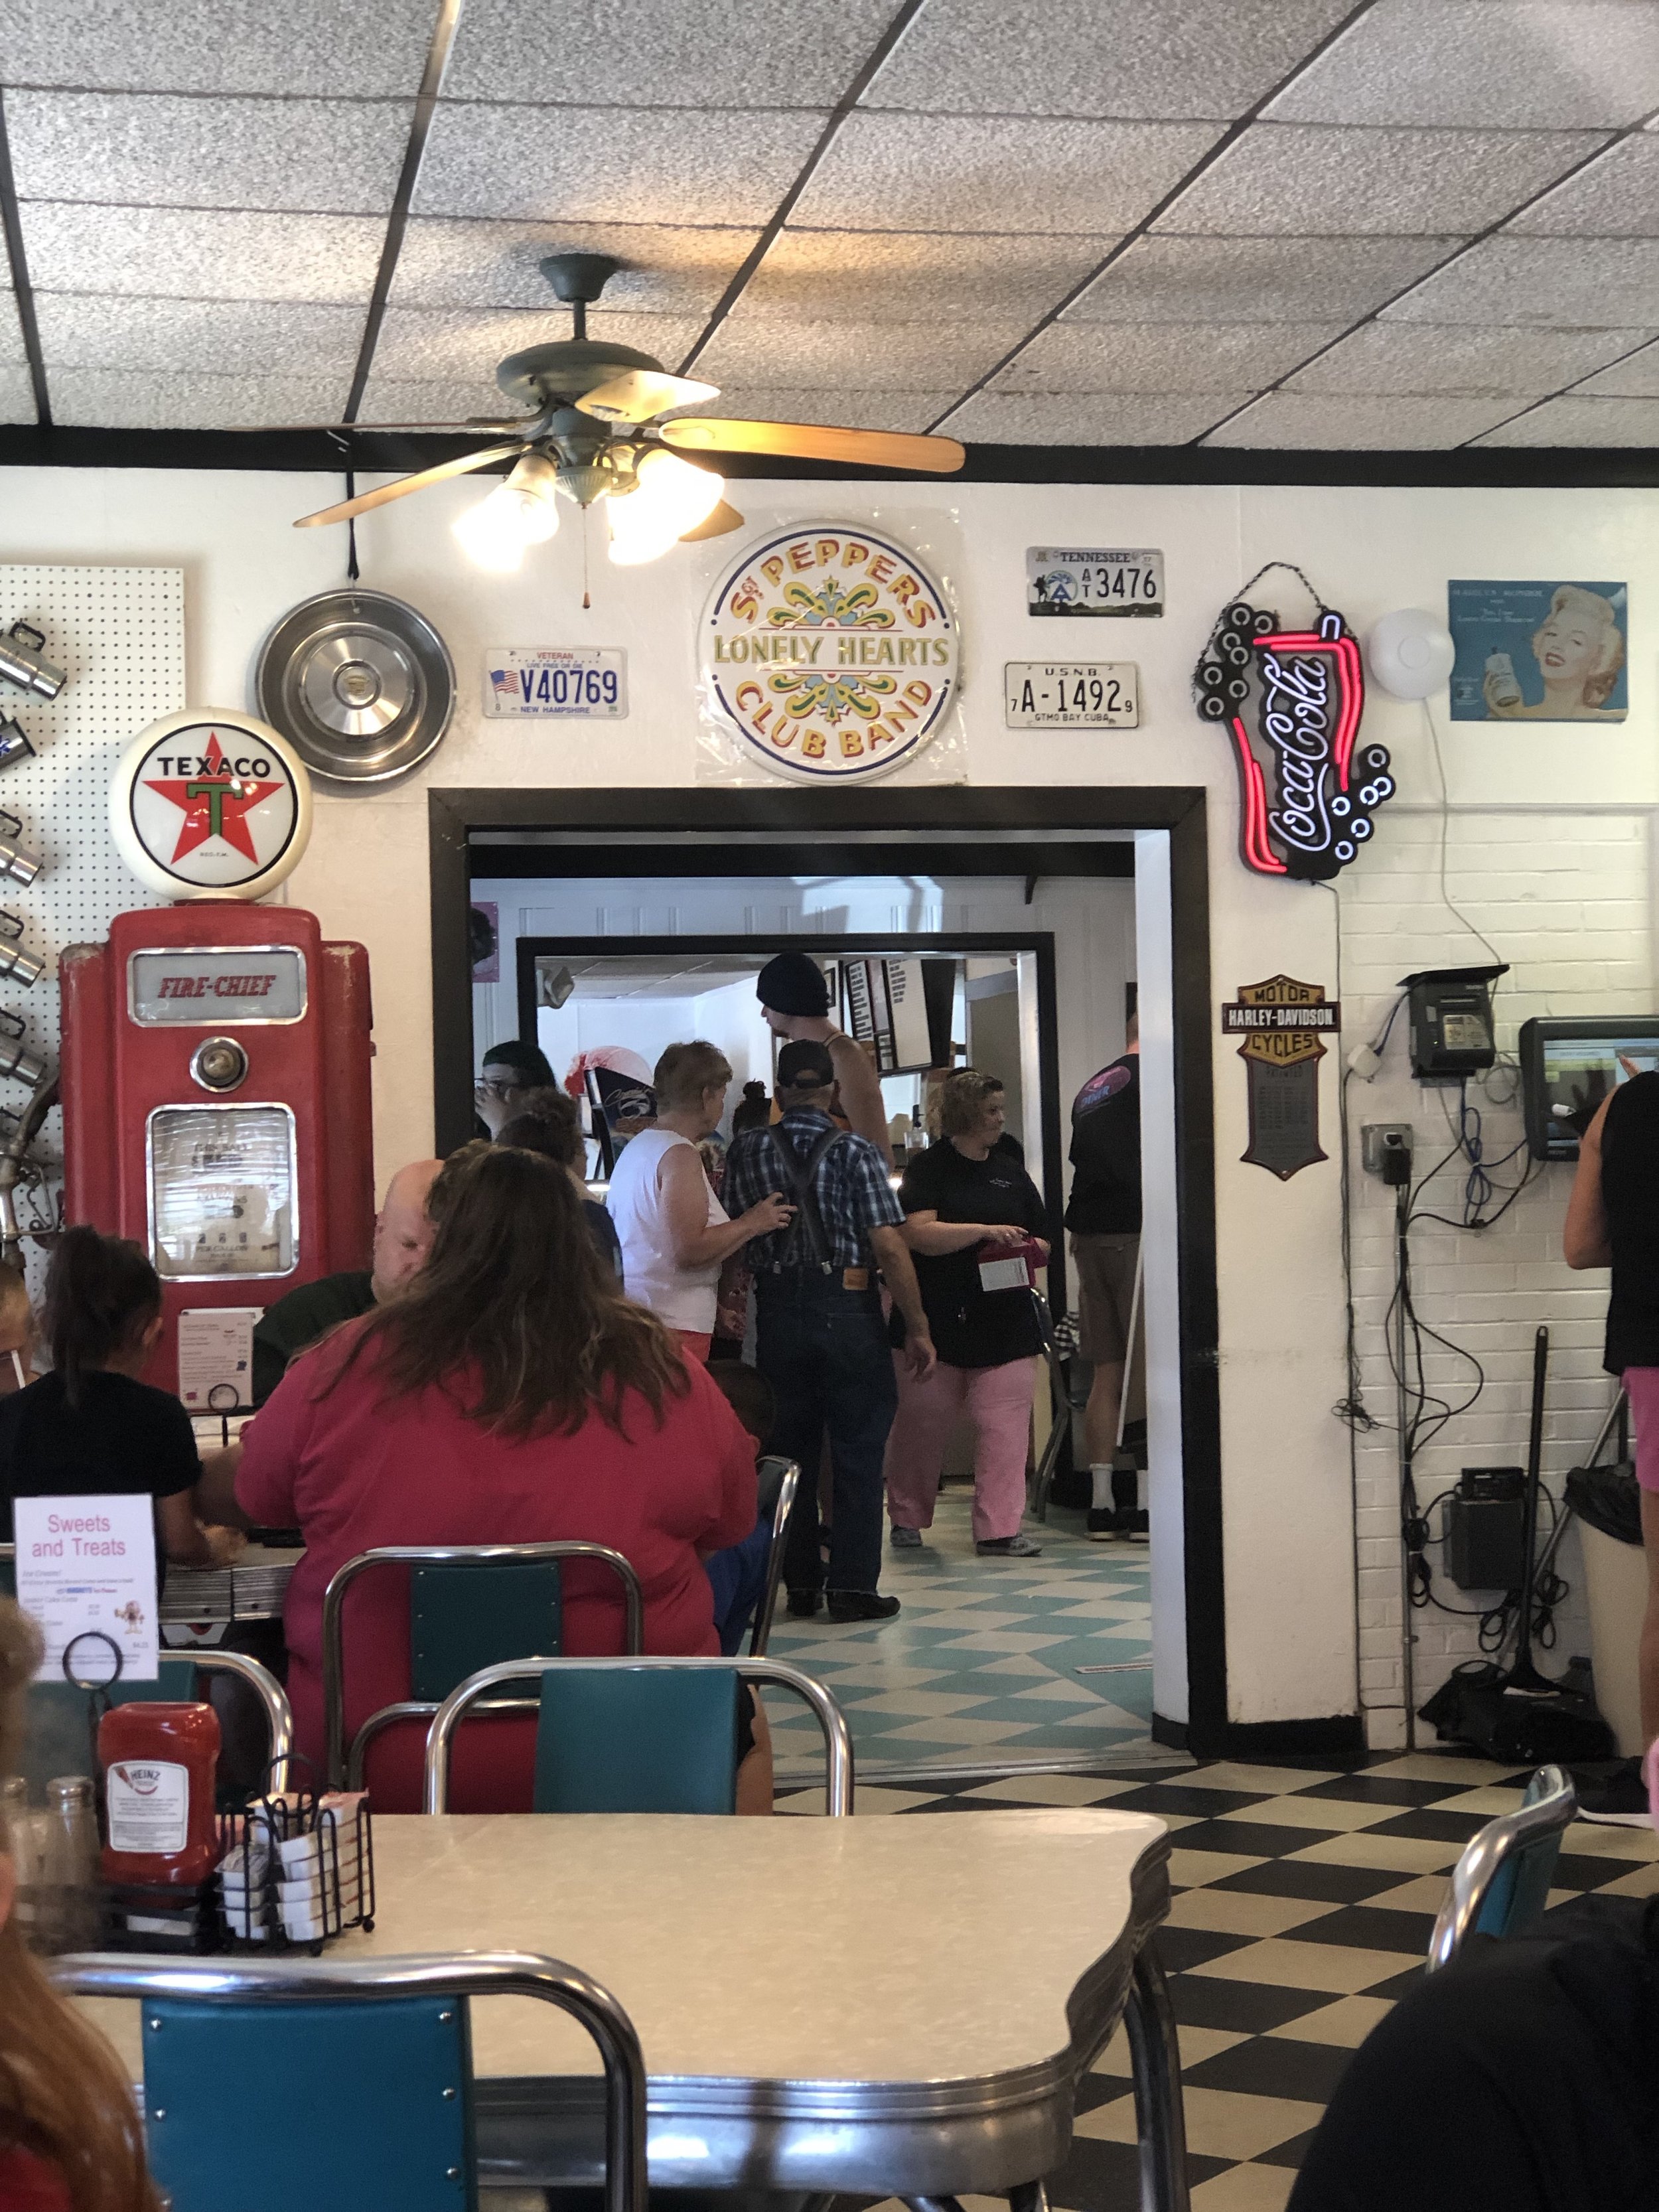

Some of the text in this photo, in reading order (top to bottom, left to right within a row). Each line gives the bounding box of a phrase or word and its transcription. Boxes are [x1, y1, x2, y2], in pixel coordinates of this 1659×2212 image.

[1060, 552, 1130, 562] TENNESSEE
[760, 538, 936, 628] PEPPERS
[1096, 568, 1157, 598] 3476
[838, 636, 949, 666] HEARTS
[520, 669, 617, 703] V40769
[1022, 680, 1121, 712] A-1492
[736, 680, 932, 759] CLUB BAND
[1263, 652, 1331, 851] Coca-Cola
[157, 757, 271, 778] TEXACO
[158, 975, 276, 998] FIRE-CHIEF
[1254, 982, 1309, 1003] MOTOR
[1229, 1009, 1334, 1026] HARLEY-DAVIDSON
[1252, 1033, 1313, 1057] CYCLES
[48, 1514, 110, 1532] Sweets
[33, 1538, 126, 1557] and Treats
[131, 1769, 161, 1781] HEINZ
